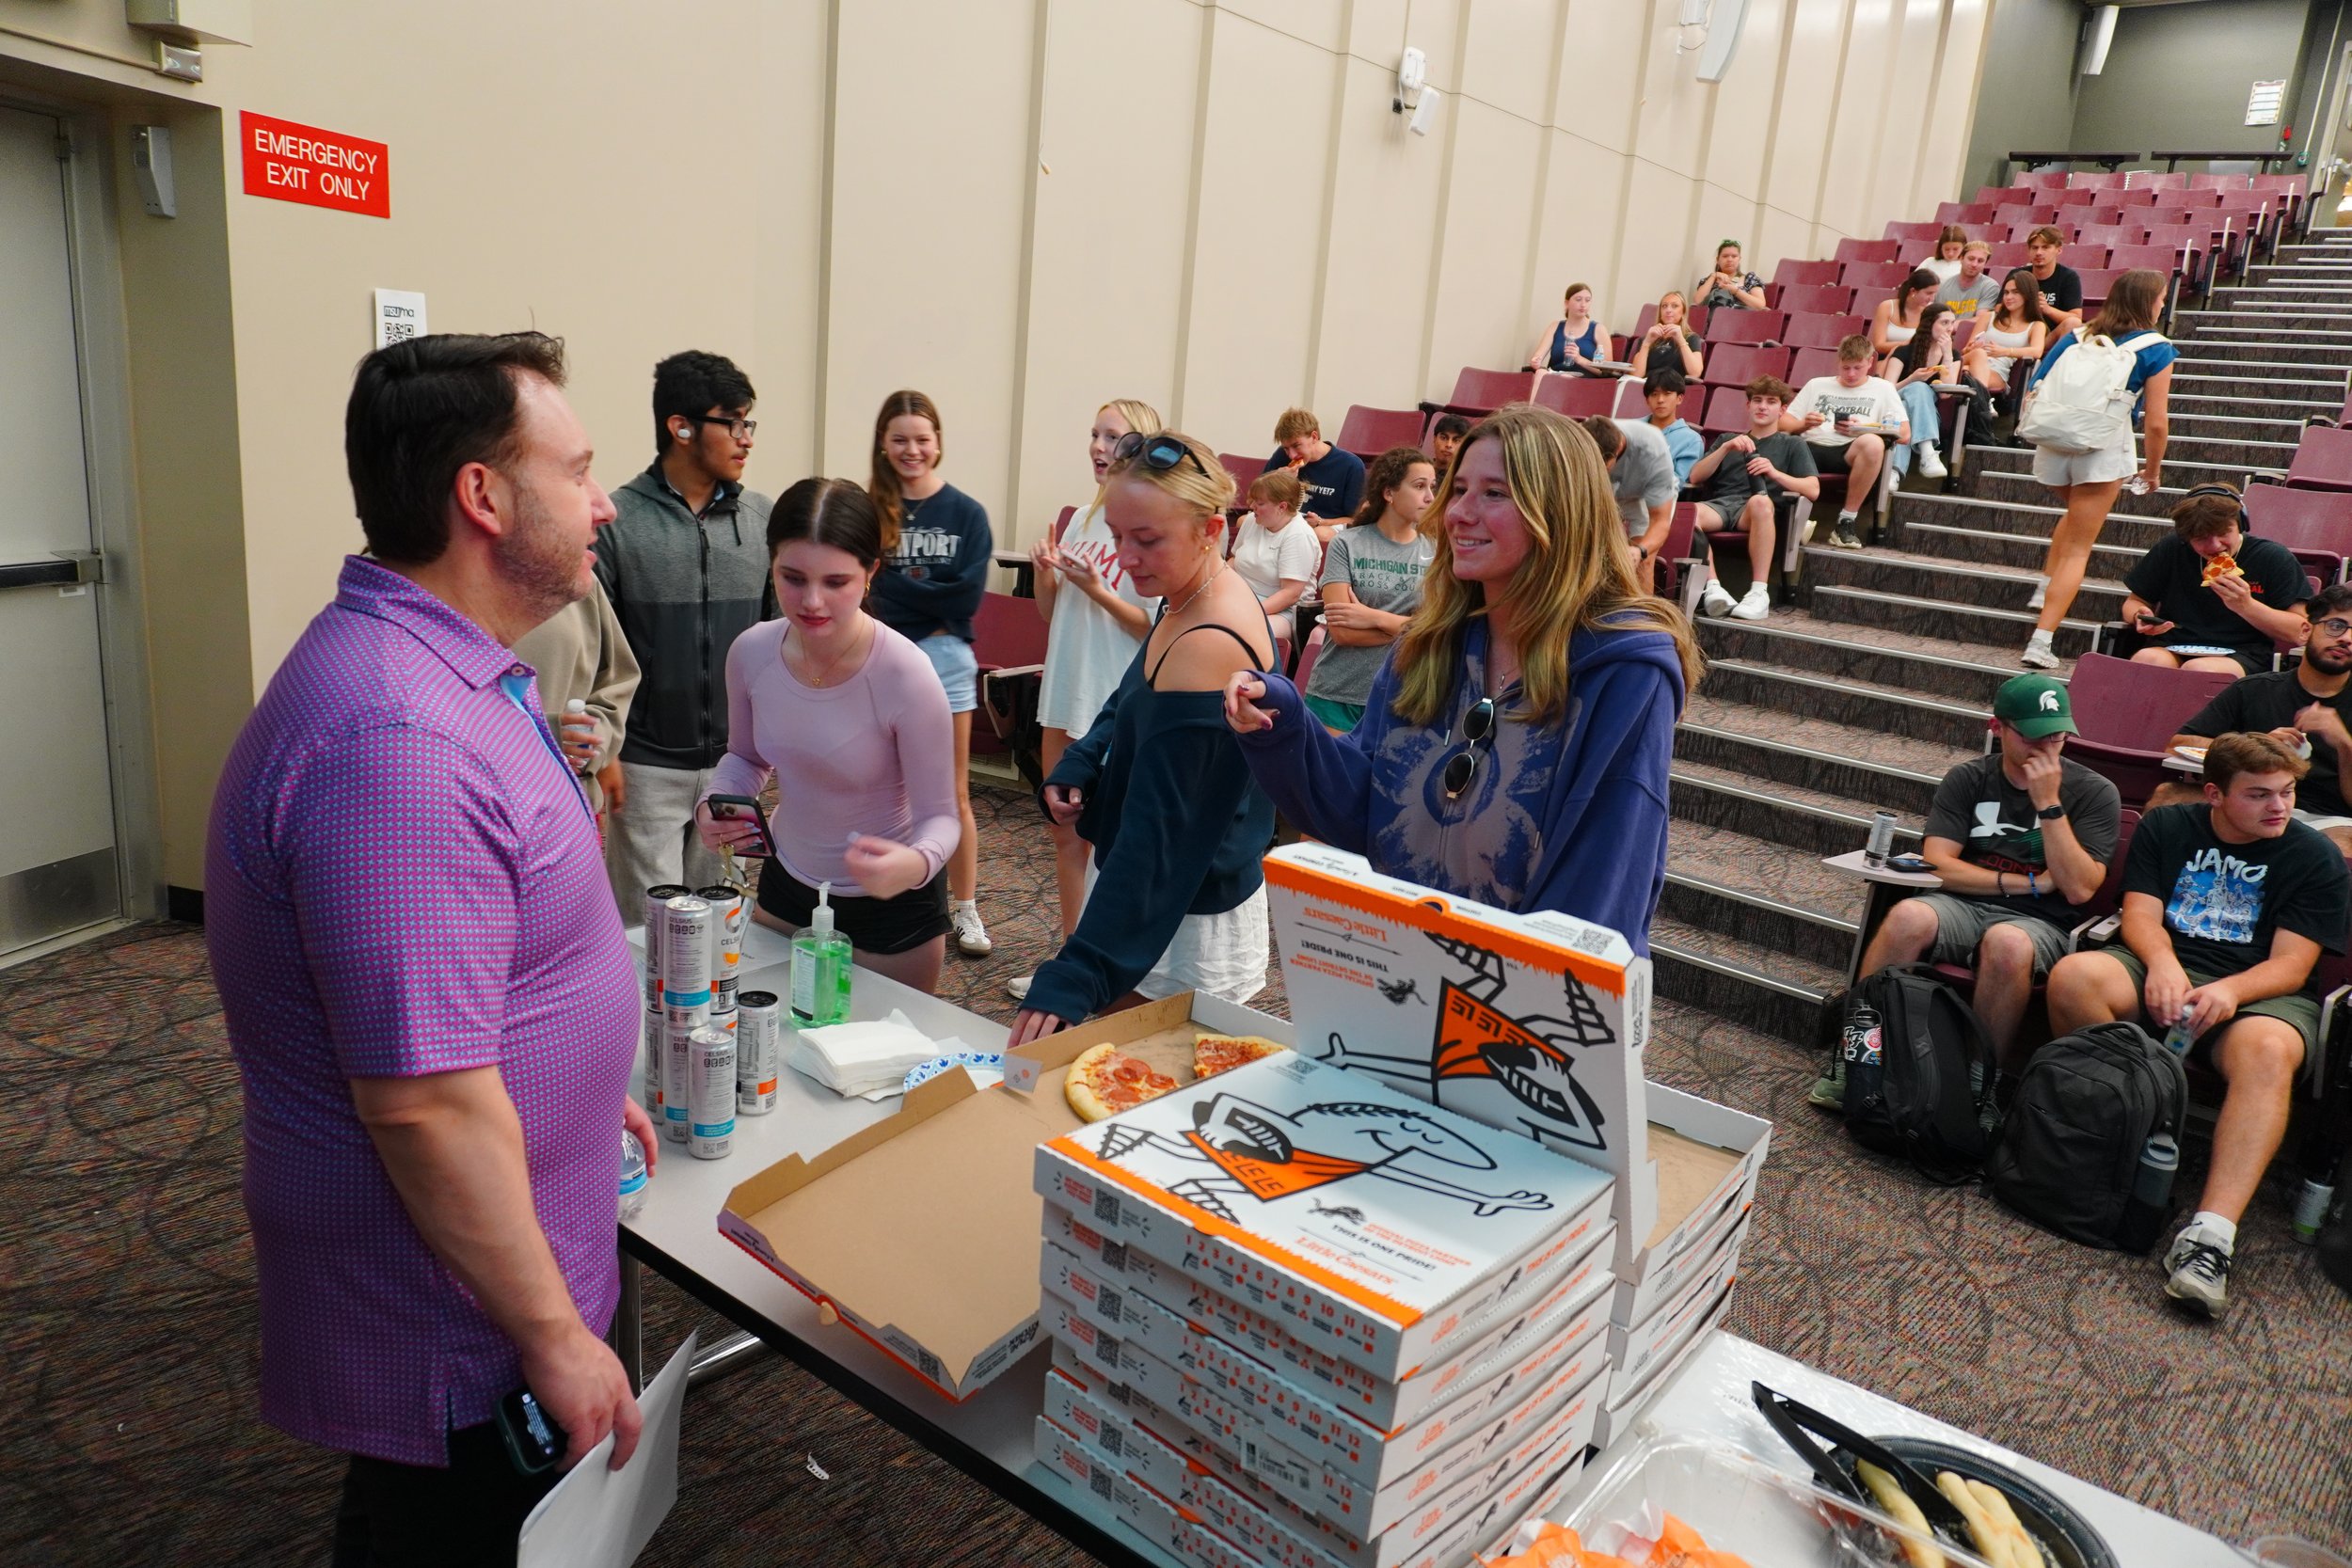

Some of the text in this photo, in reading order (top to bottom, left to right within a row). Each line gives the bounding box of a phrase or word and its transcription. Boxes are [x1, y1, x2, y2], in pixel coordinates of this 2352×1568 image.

[255, 128, 377, 175] EMERGENCY
[266, 161, 370, 201] EXIT ONLY
[1319, 486, 1336, 496] YET?
[1353, 557, 1407, 575] MICHIGAN
[2185, 847, 2268, 883] JAMO
[1303, 907, 1388, 942] Little Caesars
[1301, 940, 1389, 974] THIS IS ONE PRIDE!
[1295, 1234, 1394, 1286] Little Caesars
[1332, 1225, 1438, 1272] THIS IS ONE PRIDE!
[1321, 1305, 1334, 1317] 10
[1343, 1314, 1356, 1328] 11
[1362, 1323, 1375, 1338] 12
[1309, 1411, 1321, 1424] 10
[1330, 1423, 1342, 1436] 11
[1347, 1433, 1360, 1448] 12
[1323, 1475, 1333, 1488] 11
[1340, 1485, 1352, 1498] 12
